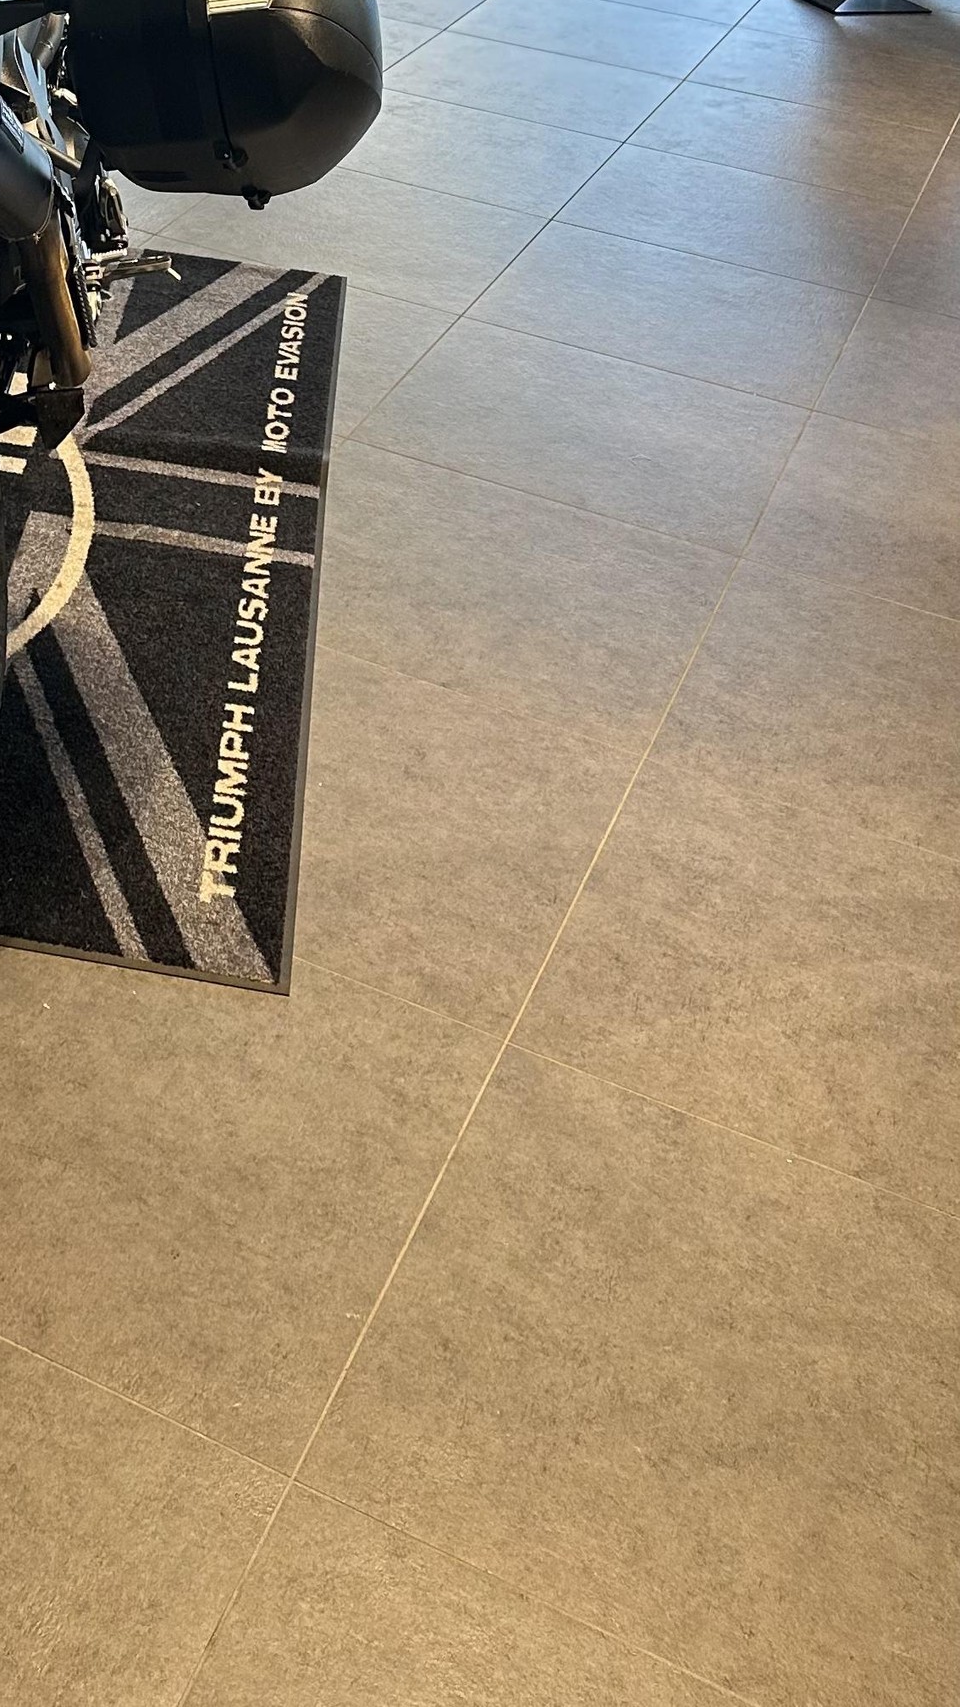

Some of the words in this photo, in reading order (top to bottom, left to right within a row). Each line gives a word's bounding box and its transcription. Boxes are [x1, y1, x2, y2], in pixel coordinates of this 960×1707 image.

[274, 292, 309, 381] EVASION
[261, 387, 295, 454] MOTO
[253, 468, 283, 507] BY
[228, 512, 279, 694] LAUSANNE
[199, 703, 255, 904] TRIUMPH
